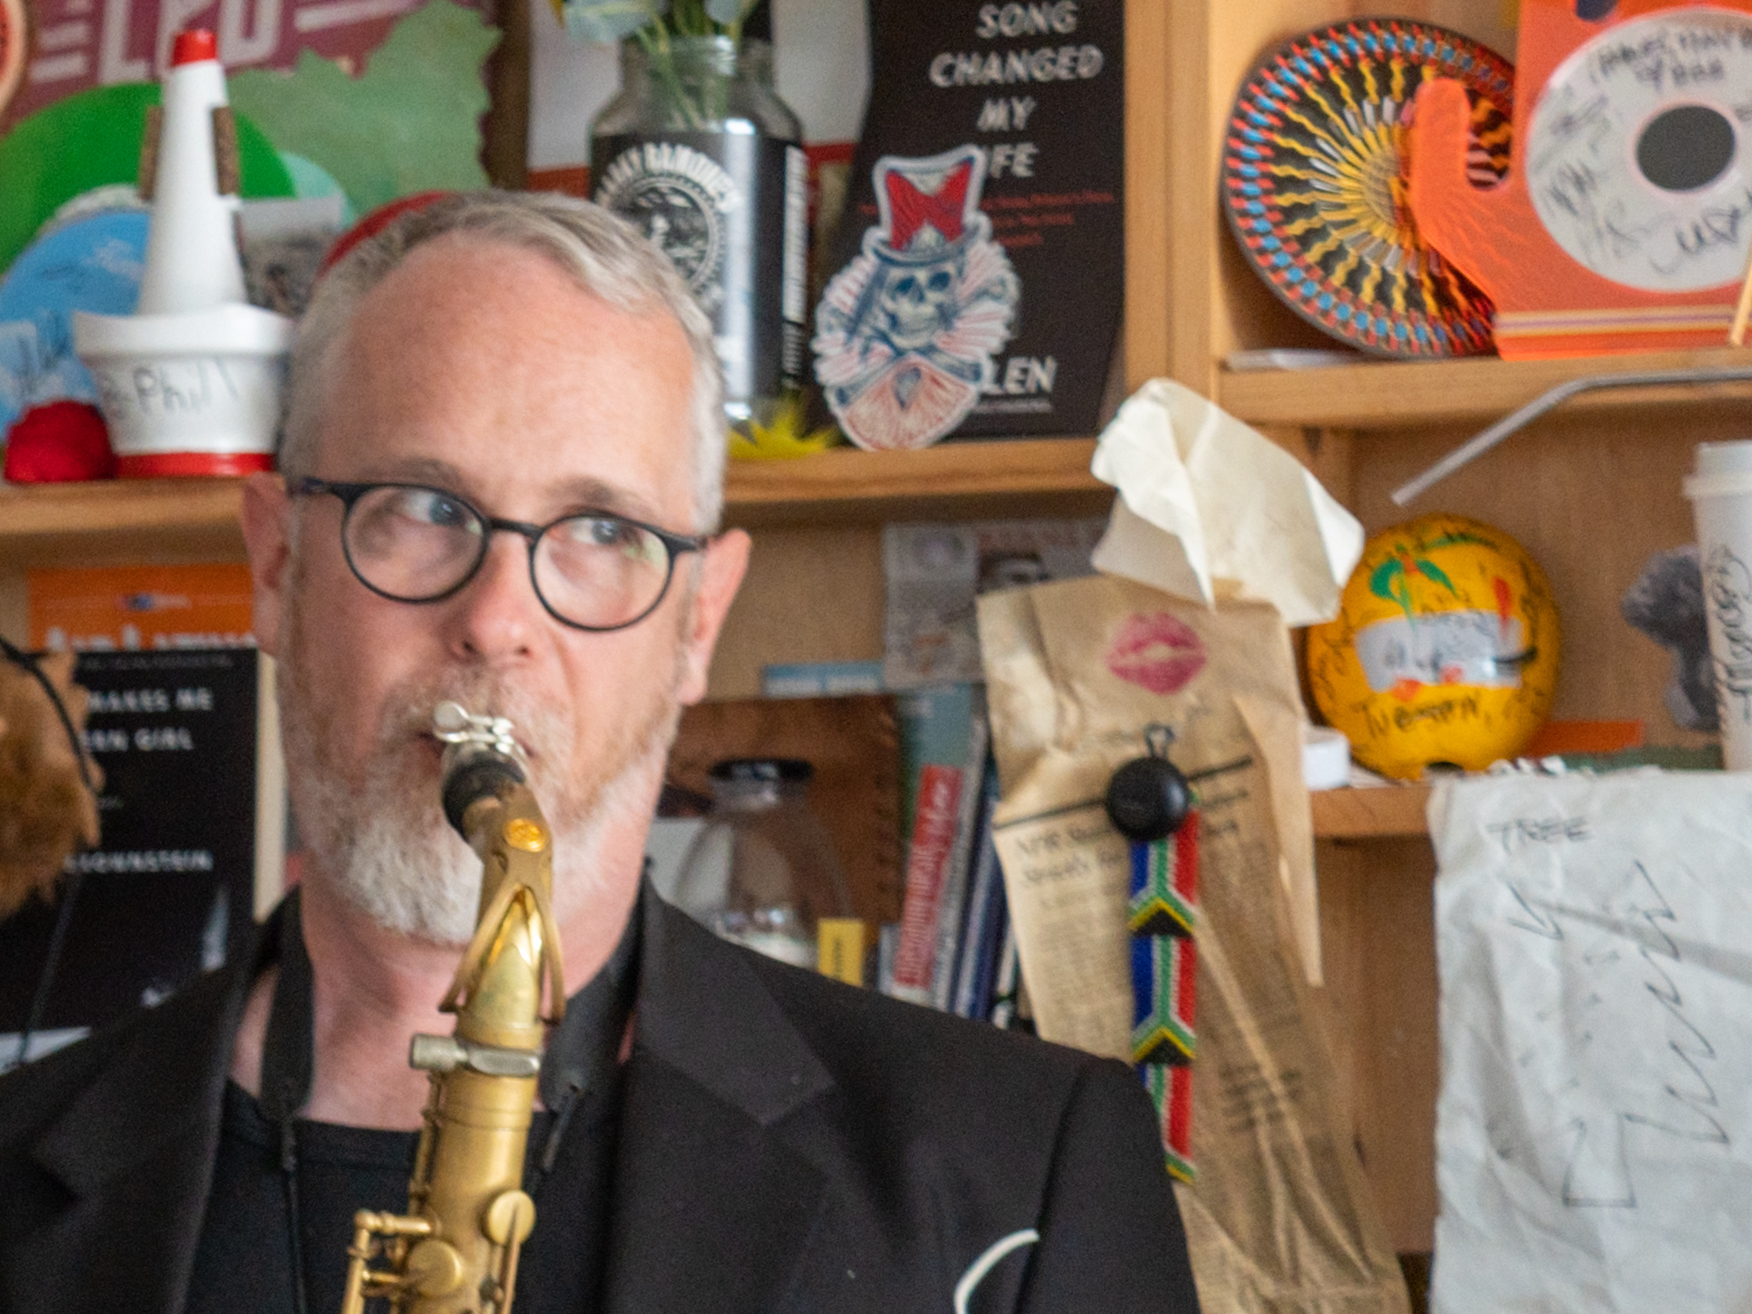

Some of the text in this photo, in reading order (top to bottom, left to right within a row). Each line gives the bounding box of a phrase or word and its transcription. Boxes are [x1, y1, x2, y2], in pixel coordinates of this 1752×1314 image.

[977, 2, 1078, 39] SONG
[930, 44, 1105, 88] CHANGED
[976, 97, 1038, 132] MY
[1486, 816, 1592, 852] TREE
